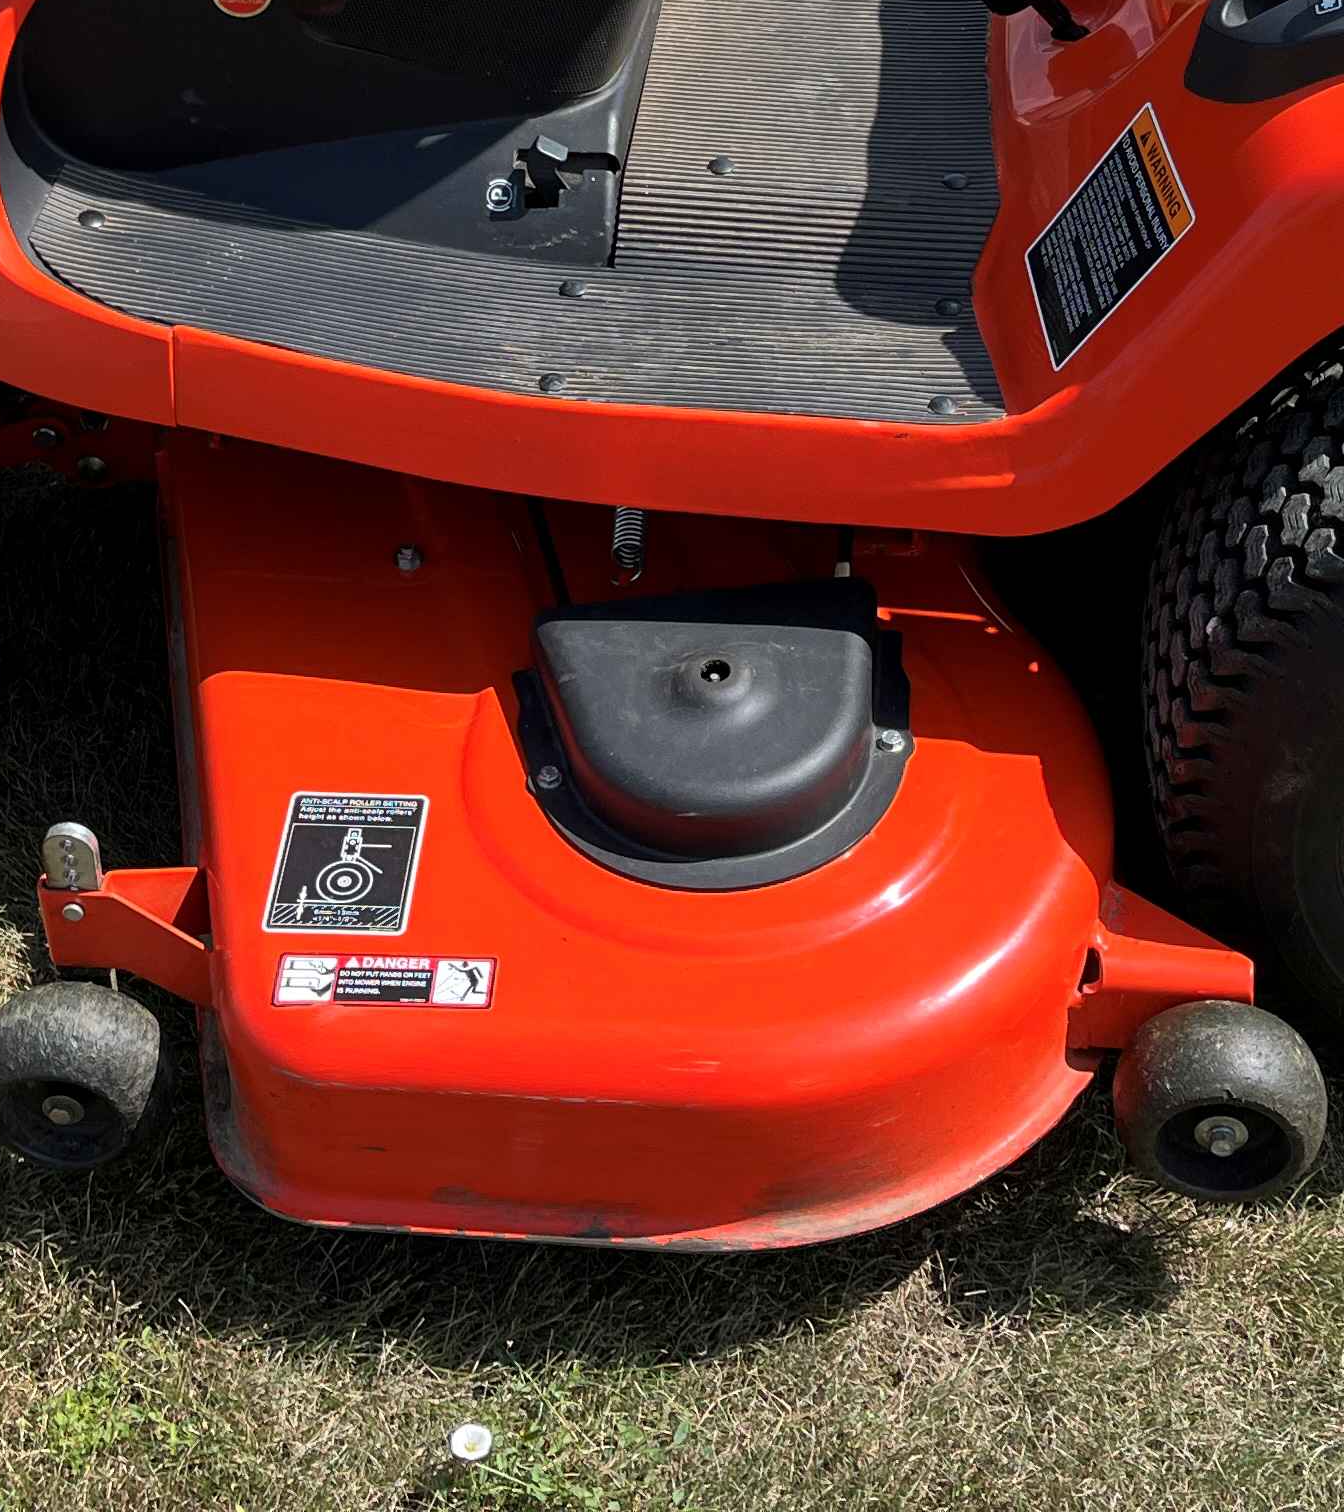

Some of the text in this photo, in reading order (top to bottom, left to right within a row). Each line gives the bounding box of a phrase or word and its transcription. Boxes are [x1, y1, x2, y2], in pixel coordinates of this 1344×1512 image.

[1121, 132, 1169, 252] TO AVOID PERSONAL INJURY
[1145, 142, 1182, 220] WARNING
[300, 798, 418, 808] ANTI-SCALP ROLLER SETTING
[362, 957, 430, 970] DANGER
